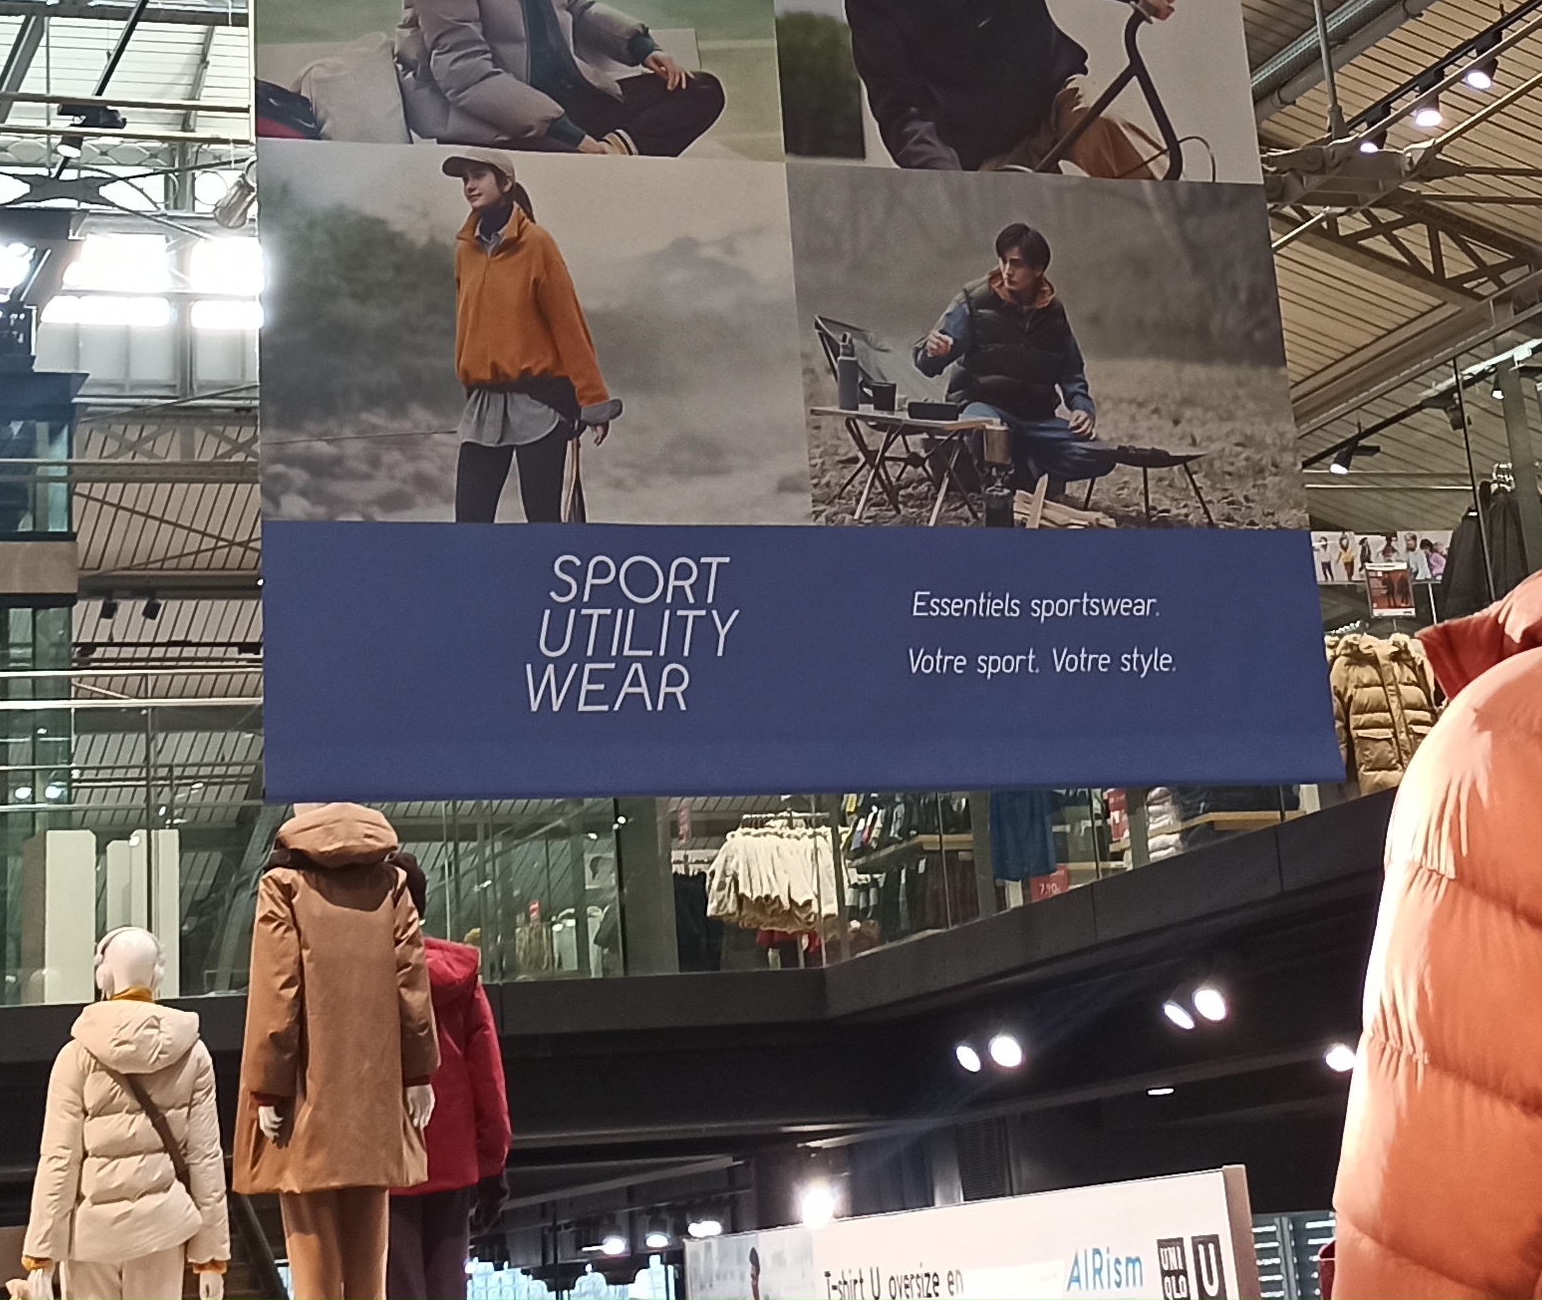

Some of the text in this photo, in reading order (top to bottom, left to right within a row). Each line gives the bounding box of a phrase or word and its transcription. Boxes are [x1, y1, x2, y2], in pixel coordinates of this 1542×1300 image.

[549, 554, 731, 604] SPORT
[912, 590, 1160, 624] Essentiels sportswear.
[539, 608, 740, 658] UTILITY
[909, 646, 1177, 680] Votre sport. Votre style.
[526, 663, 690, 713] WEAR
[1066, 1246, 1144, 1292] AIRism
[1159, 1245, 1184, 1271] UNI
[1197, 1242, 1220, 1297] U
[869, 1266, 881, 1300] U
[888, 1261, 940, 1300] oversize
[947, 1270, 964, 1297] en
[1163, 1274, 1188, 1300] QLO
